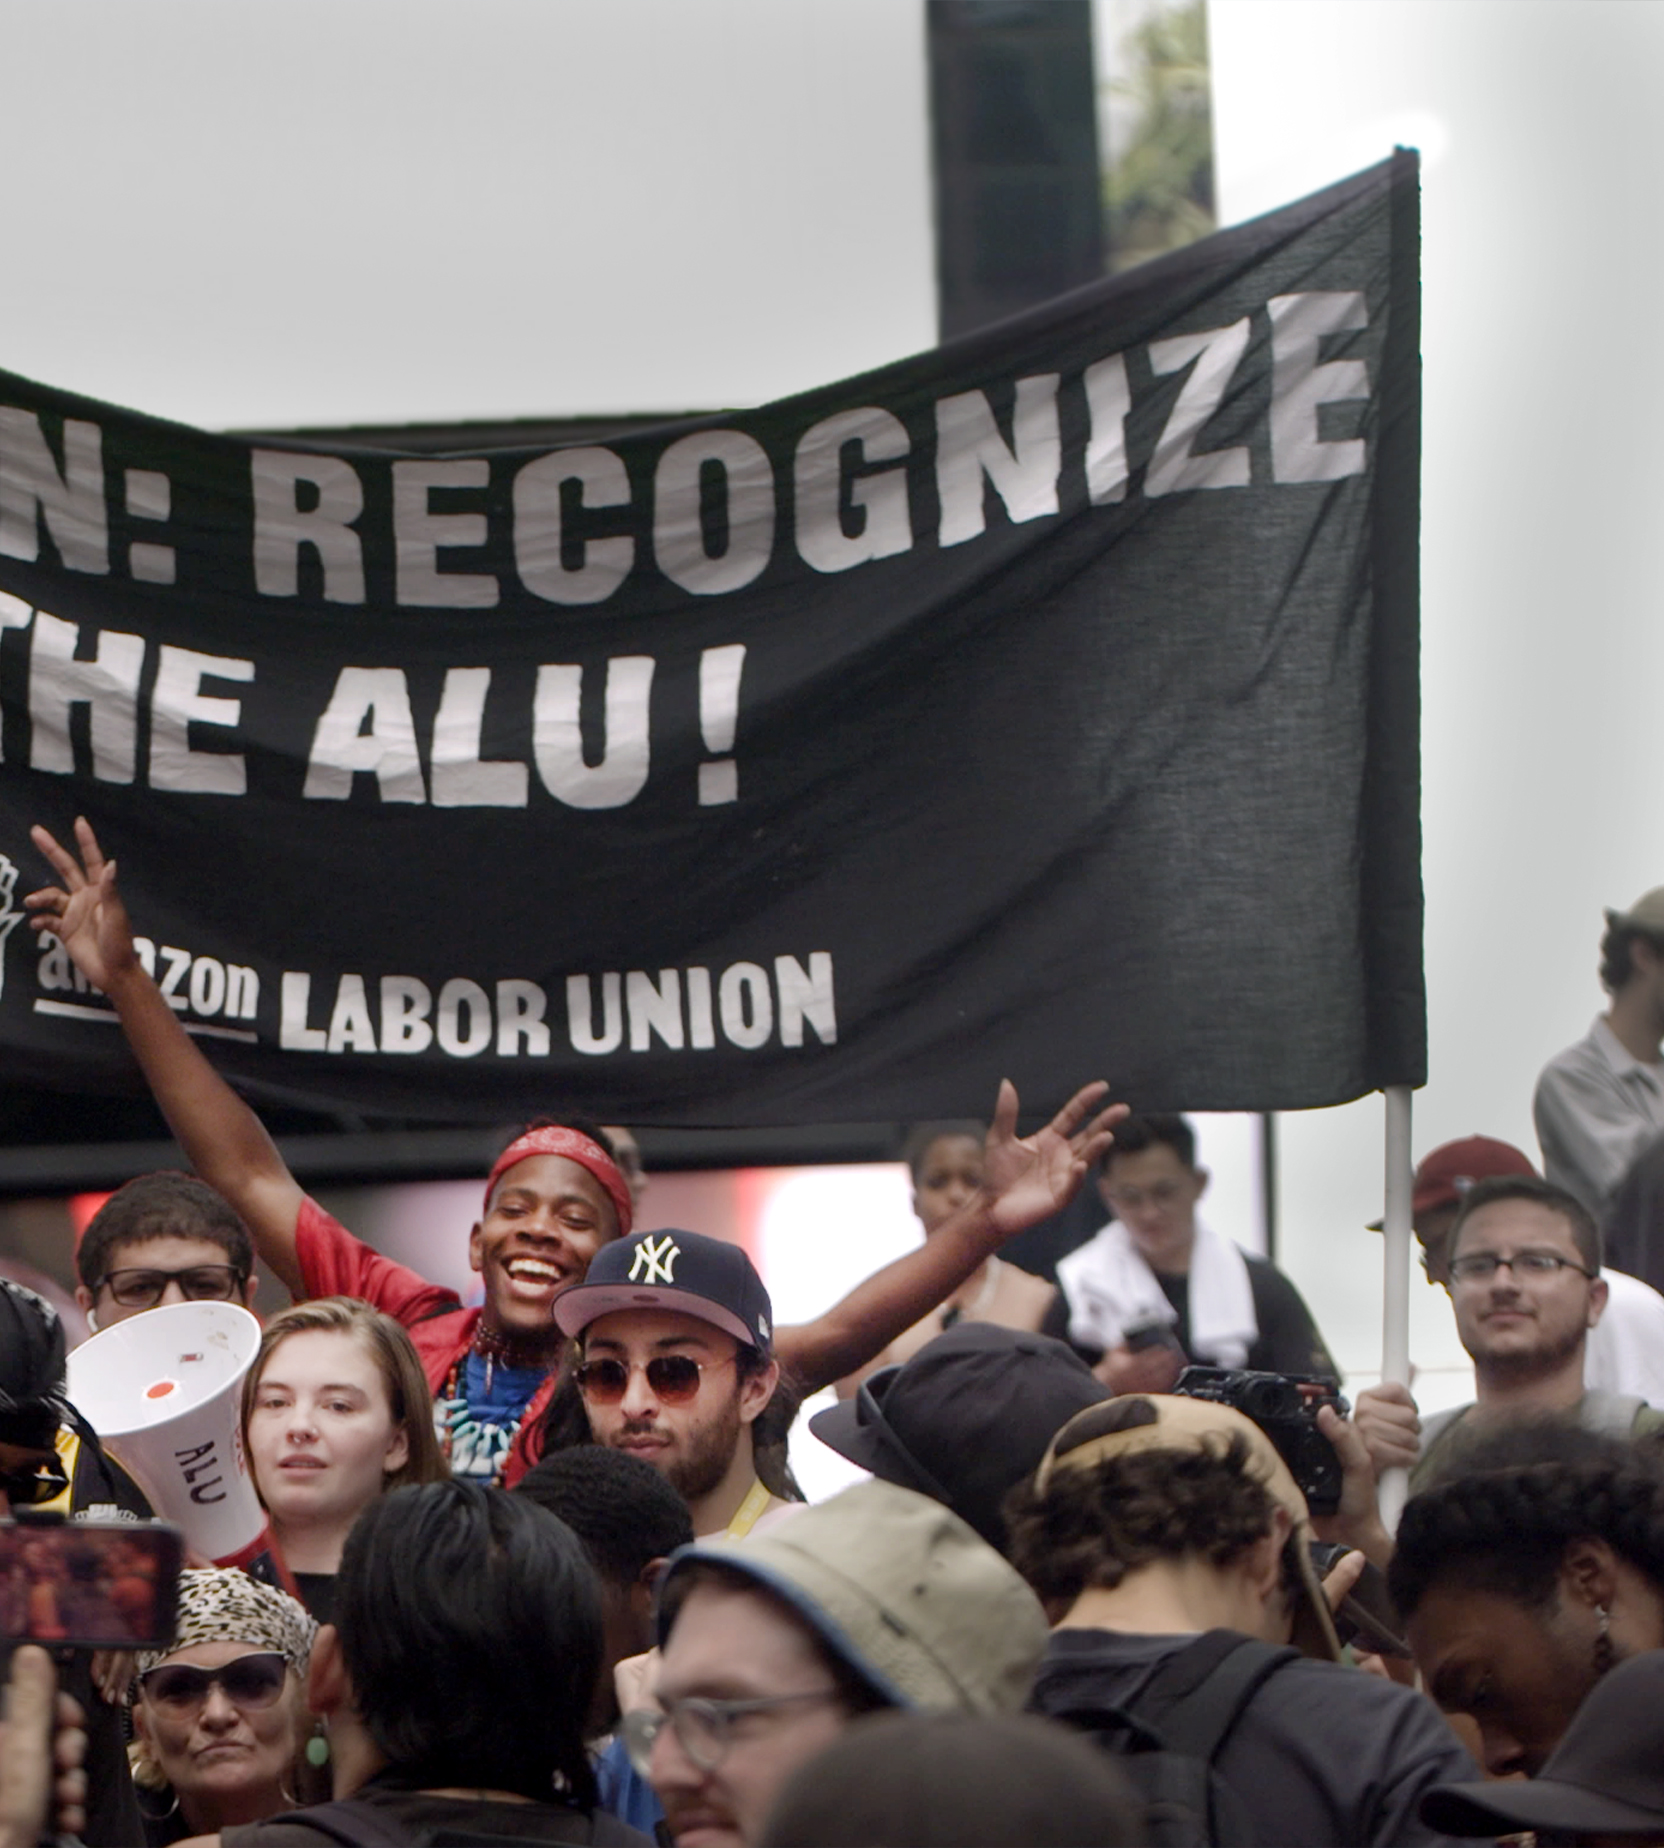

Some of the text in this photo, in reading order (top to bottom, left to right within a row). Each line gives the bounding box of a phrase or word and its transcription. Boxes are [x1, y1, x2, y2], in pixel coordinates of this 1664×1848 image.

[251, 291, 1373, 608] RECOGNIZE
[279, 971, 551, 1058] LABOR
[566, 951, 837, 1055] UNION
[628, 1235, 681, 1284] NY
[175, 1440, 227, 1504] ALU
